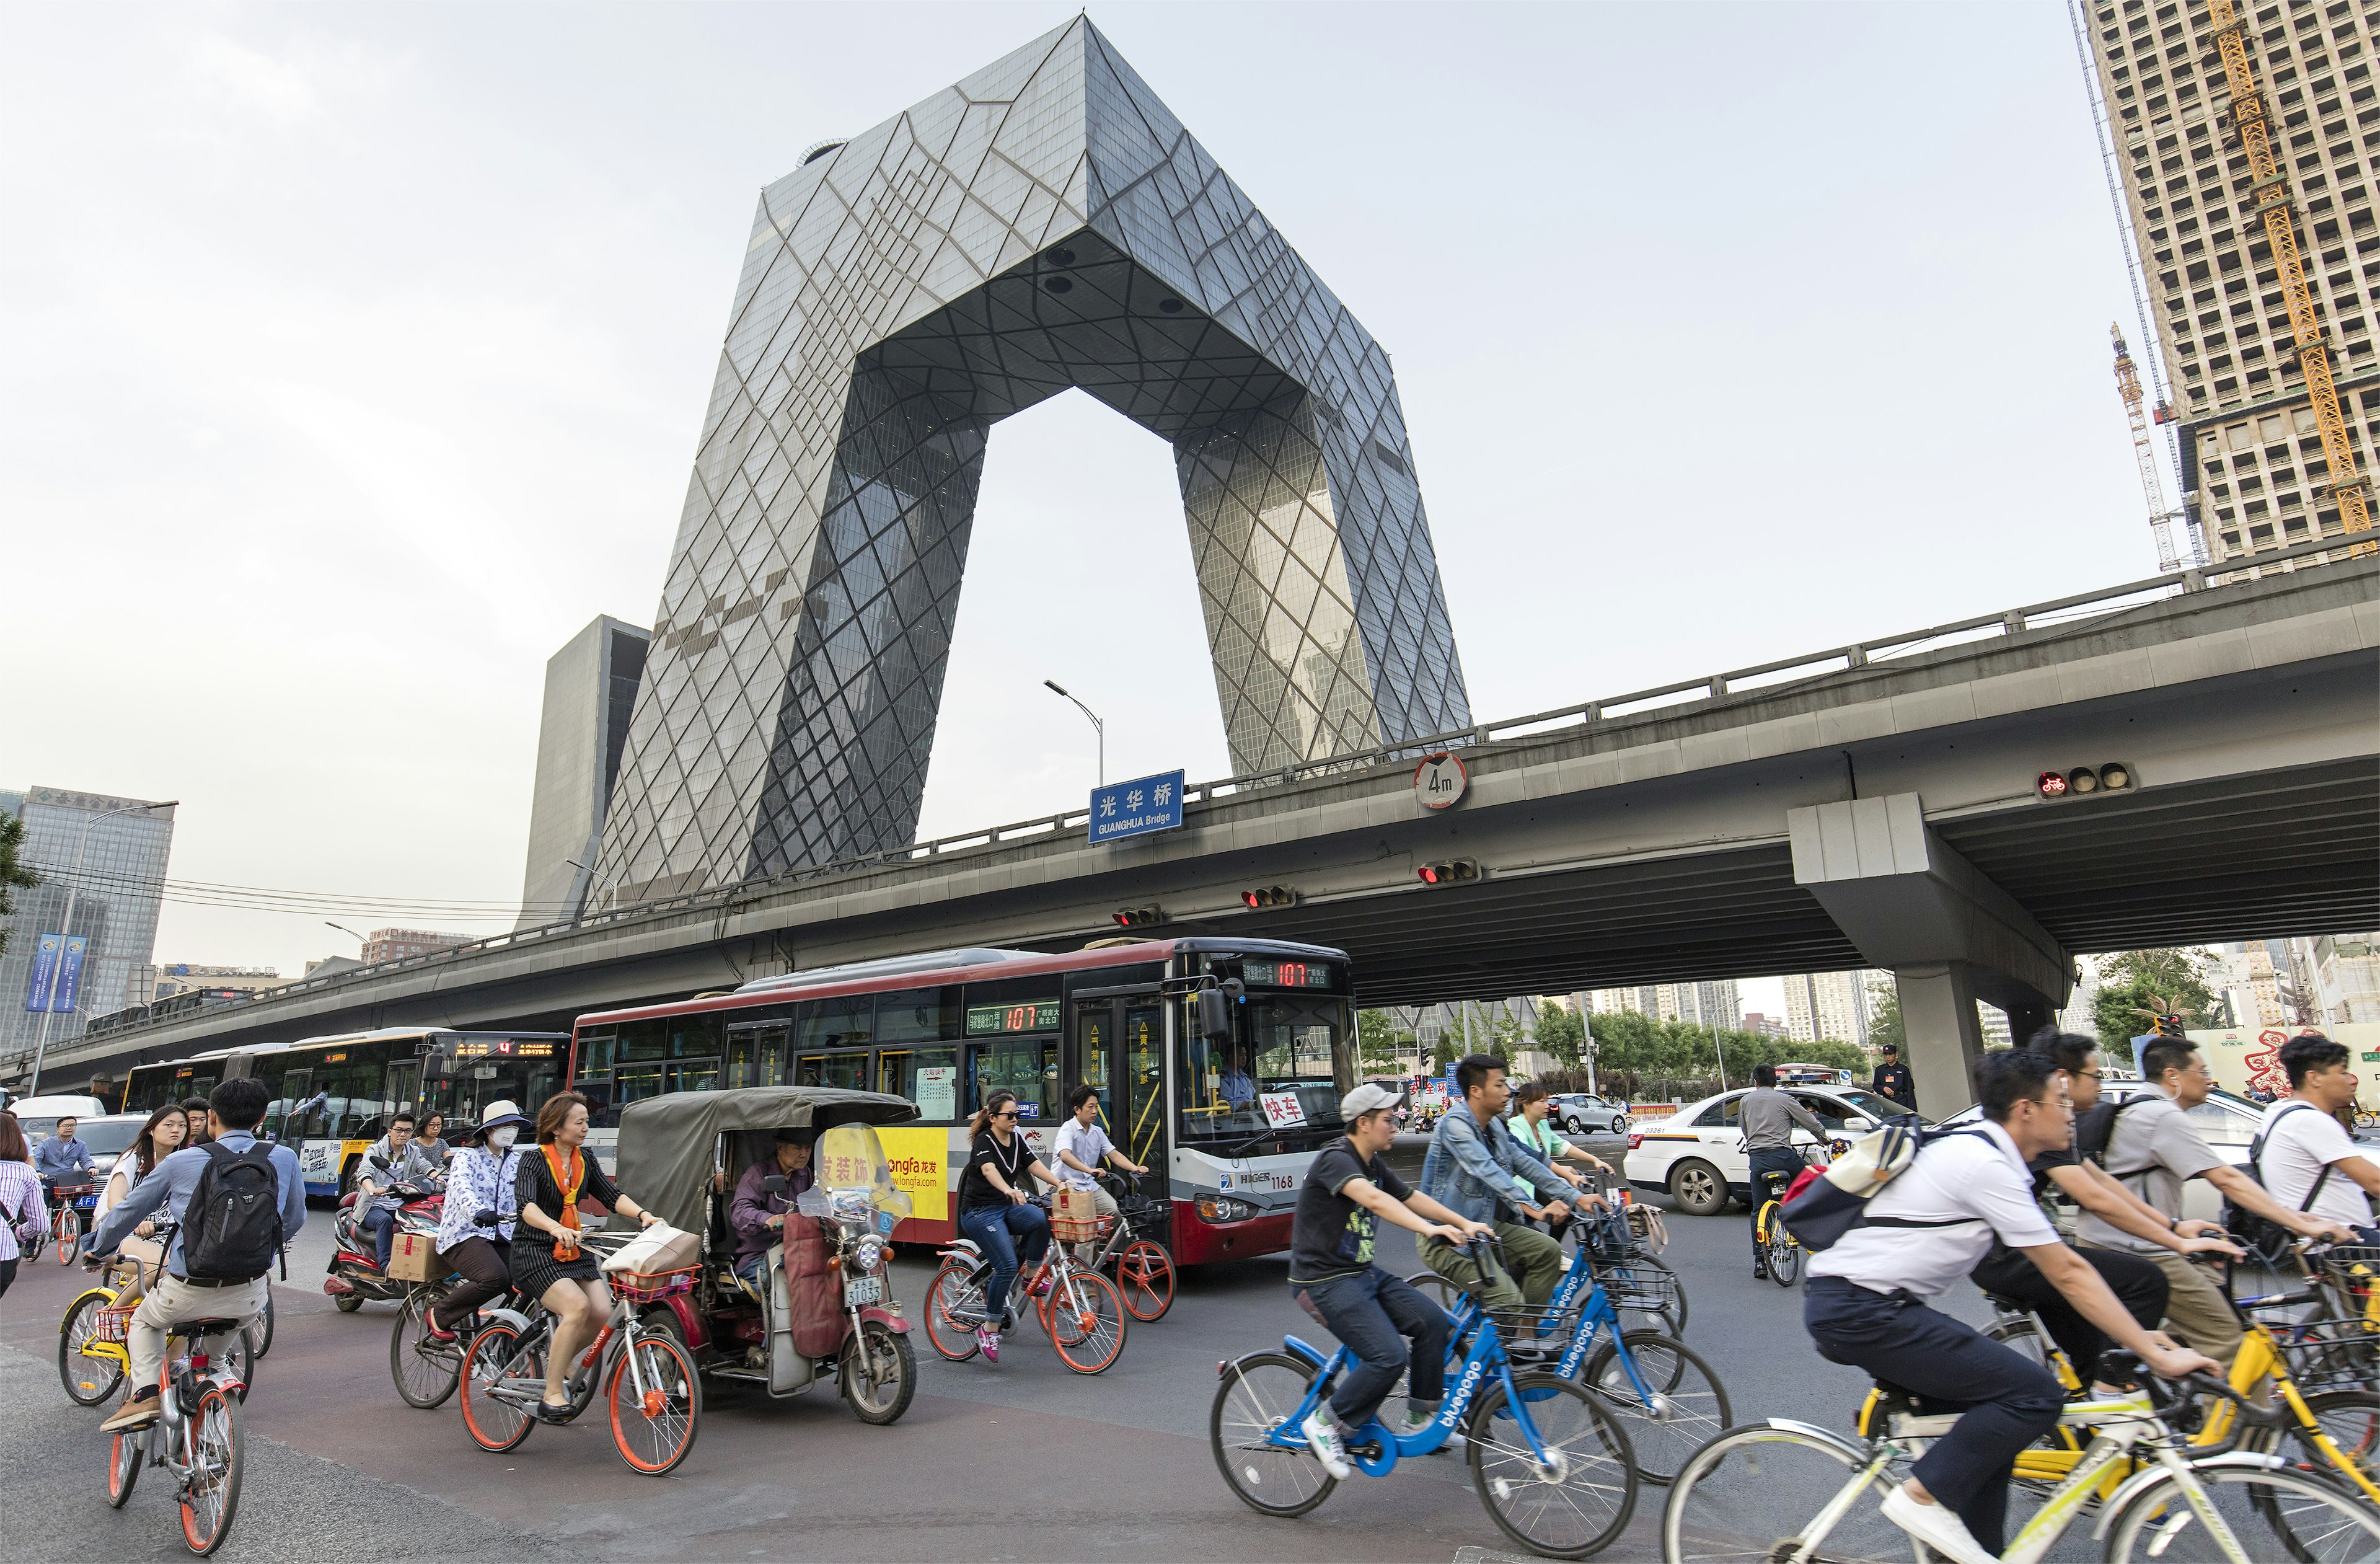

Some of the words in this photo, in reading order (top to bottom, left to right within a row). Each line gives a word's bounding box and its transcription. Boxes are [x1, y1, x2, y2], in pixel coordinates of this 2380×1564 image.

[1428, 769, 1452, 793] 4m
[1100, 782, 1172, 818] 光华桥
[1098, 817, 1144, 835] GUANGHUA
[1145, 813, 1171, 826] Bridge
[1279, 963, 1305, 986] 107
[1006, 1006, 1036, 1030] 107
[1264, 1097, 1302, 1121] 快车
[888, 1157, 919, 1175] ongfa
[921, 1161, 937, 1174] 龙发
[1240, 1172, 1271, 1184] HIGER
[1271, 1175, 1294, 1190] 1168
[848, 1286, 880, 1304] 31033
[1558, 1321, 1595, 1379] bluegogo
[1439, 1361, 1482, 1428] bluegogo
